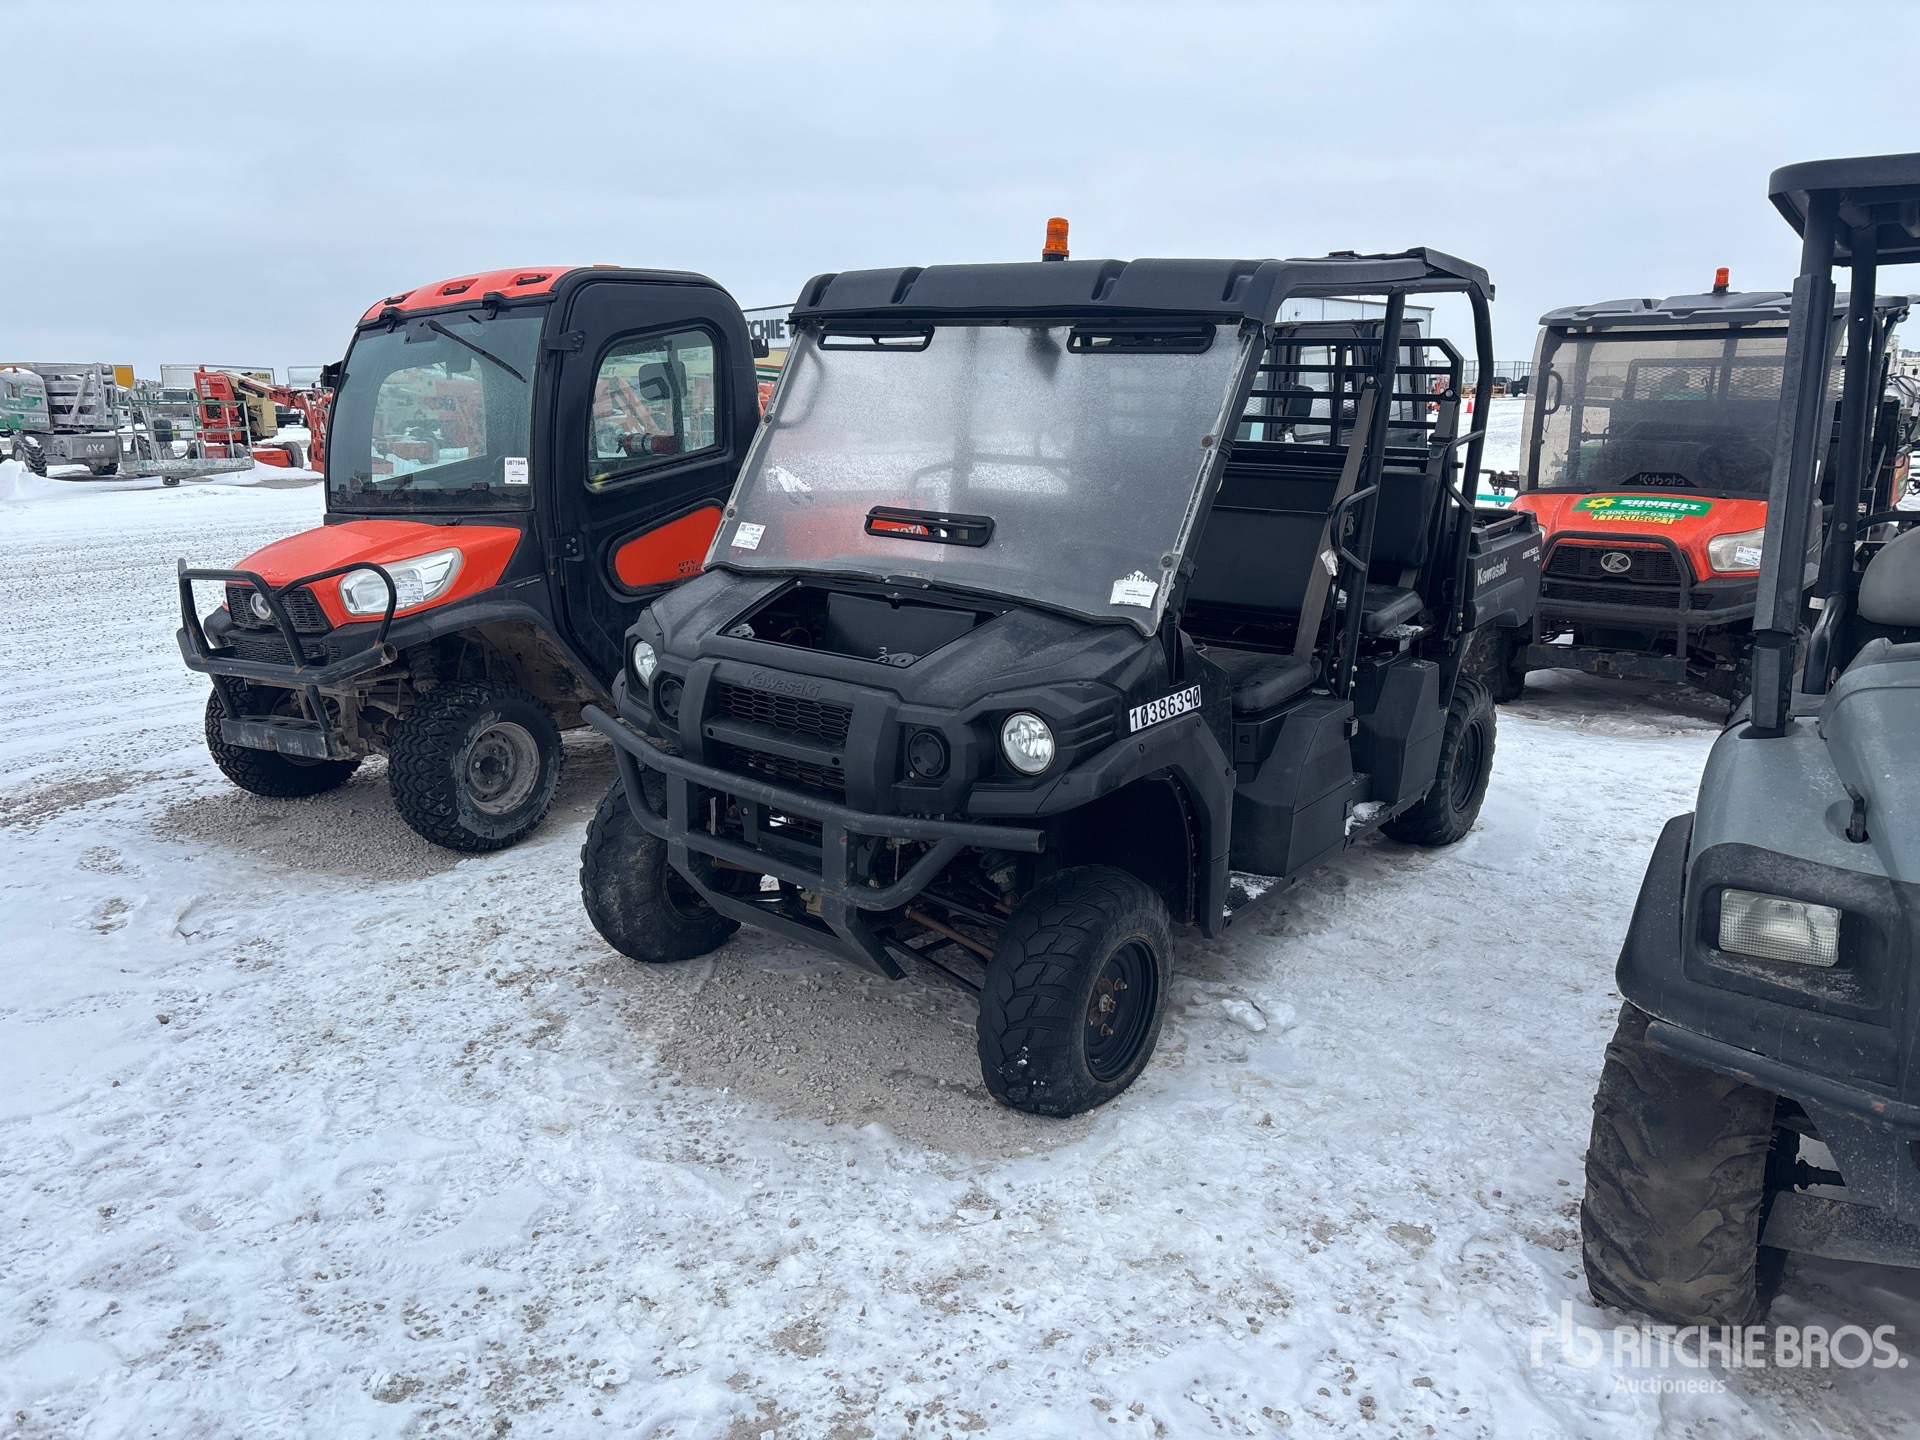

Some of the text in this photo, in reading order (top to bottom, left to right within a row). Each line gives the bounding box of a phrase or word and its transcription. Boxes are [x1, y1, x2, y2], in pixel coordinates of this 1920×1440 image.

[1639, 474, 1685, 486] Kubota
[1619, 499, 1700, 511] SUNBELT
[745, 671, 822, 698] Kawasaki
[1131, 686, 1200, 729] 10386390
